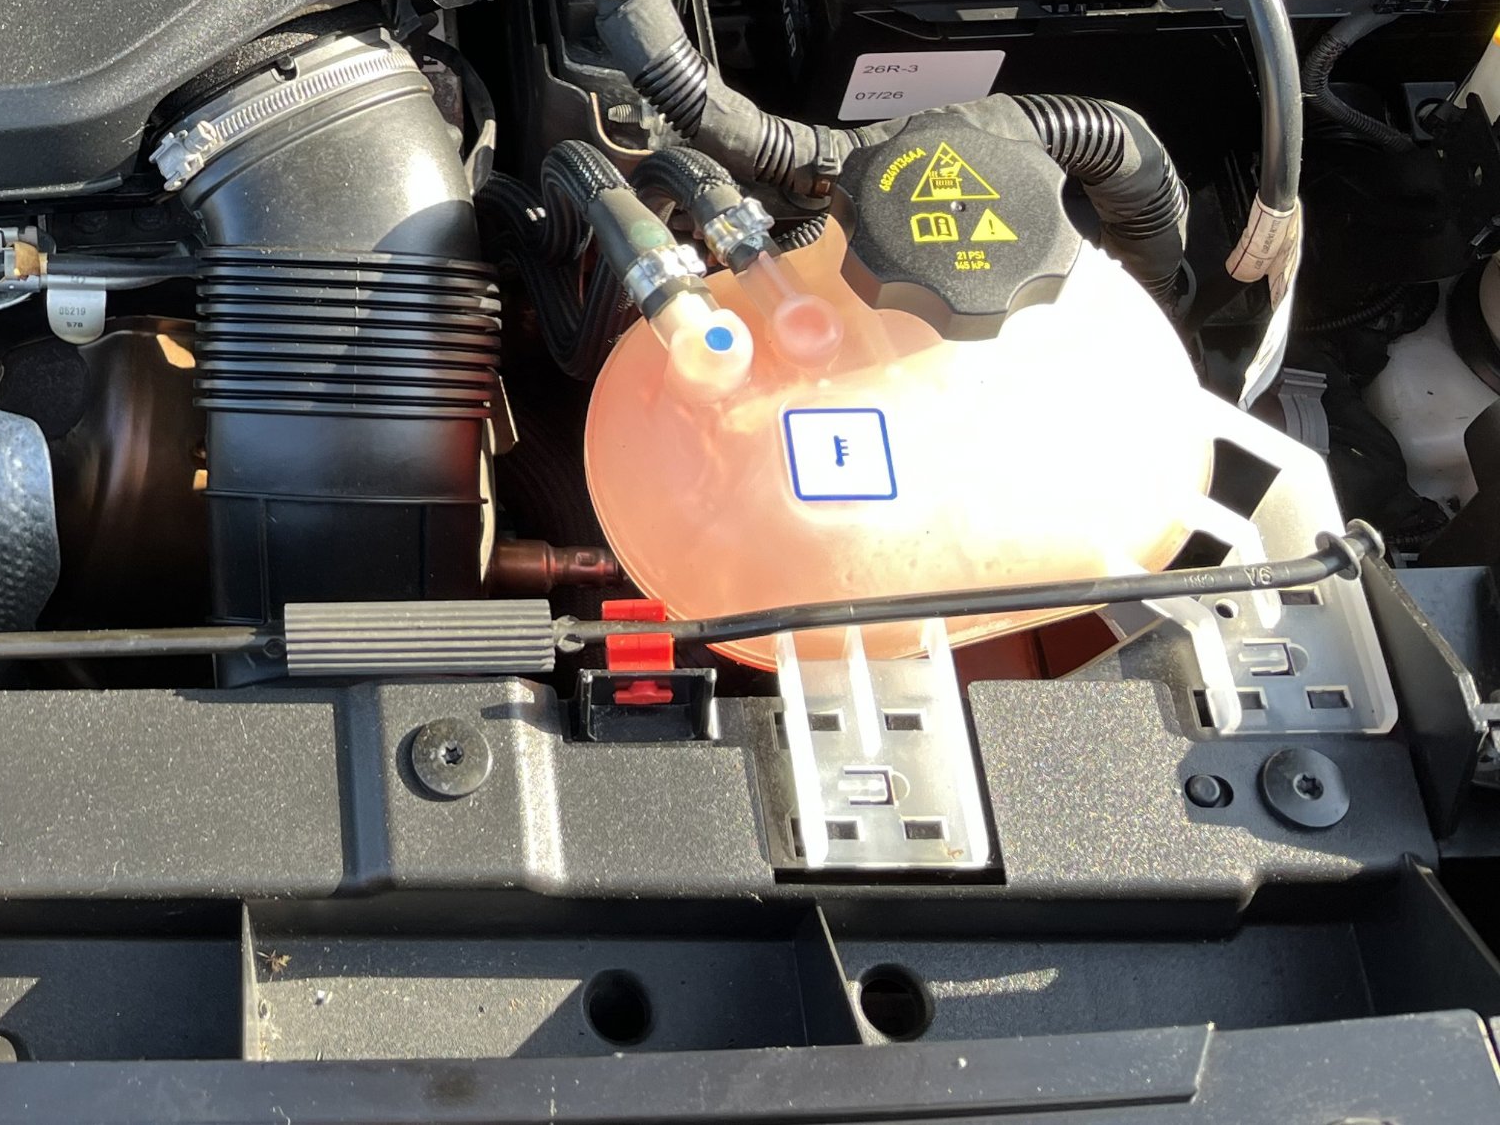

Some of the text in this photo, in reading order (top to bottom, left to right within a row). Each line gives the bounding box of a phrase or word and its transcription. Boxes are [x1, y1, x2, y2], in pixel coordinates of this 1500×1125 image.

[862, 64, 919, 74] 26R-3
[855, 91, 904, 101] 07/26
[956, 250, 985, 259] 21 PSI
[955, 260, 991, 270] 145 kPa
